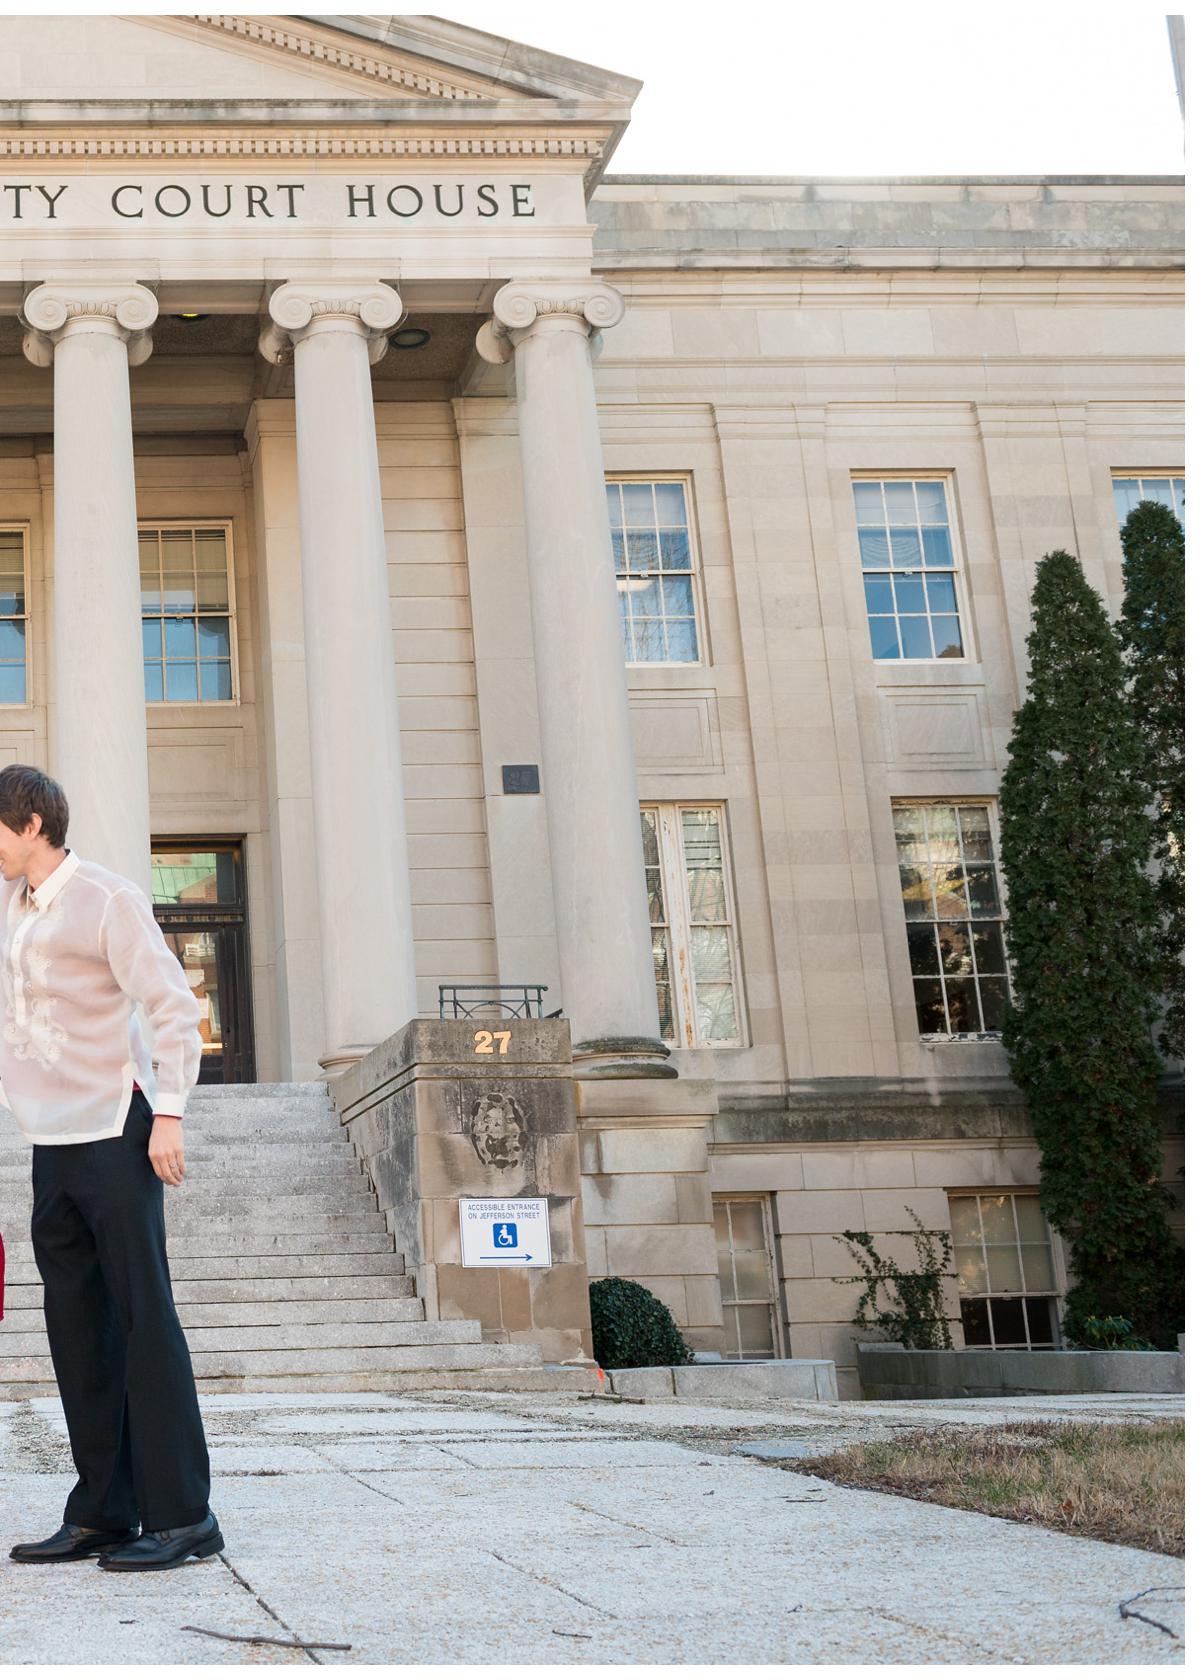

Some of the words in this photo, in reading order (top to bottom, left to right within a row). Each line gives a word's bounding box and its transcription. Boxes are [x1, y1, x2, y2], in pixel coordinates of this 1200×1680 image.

[112, 184, 306, 219] COURT
[347, 184, 536, 218] HOUSE
[474, 1031, 512, 1054] 27
[508, 1203, 541, 1211] ENTRANCE
